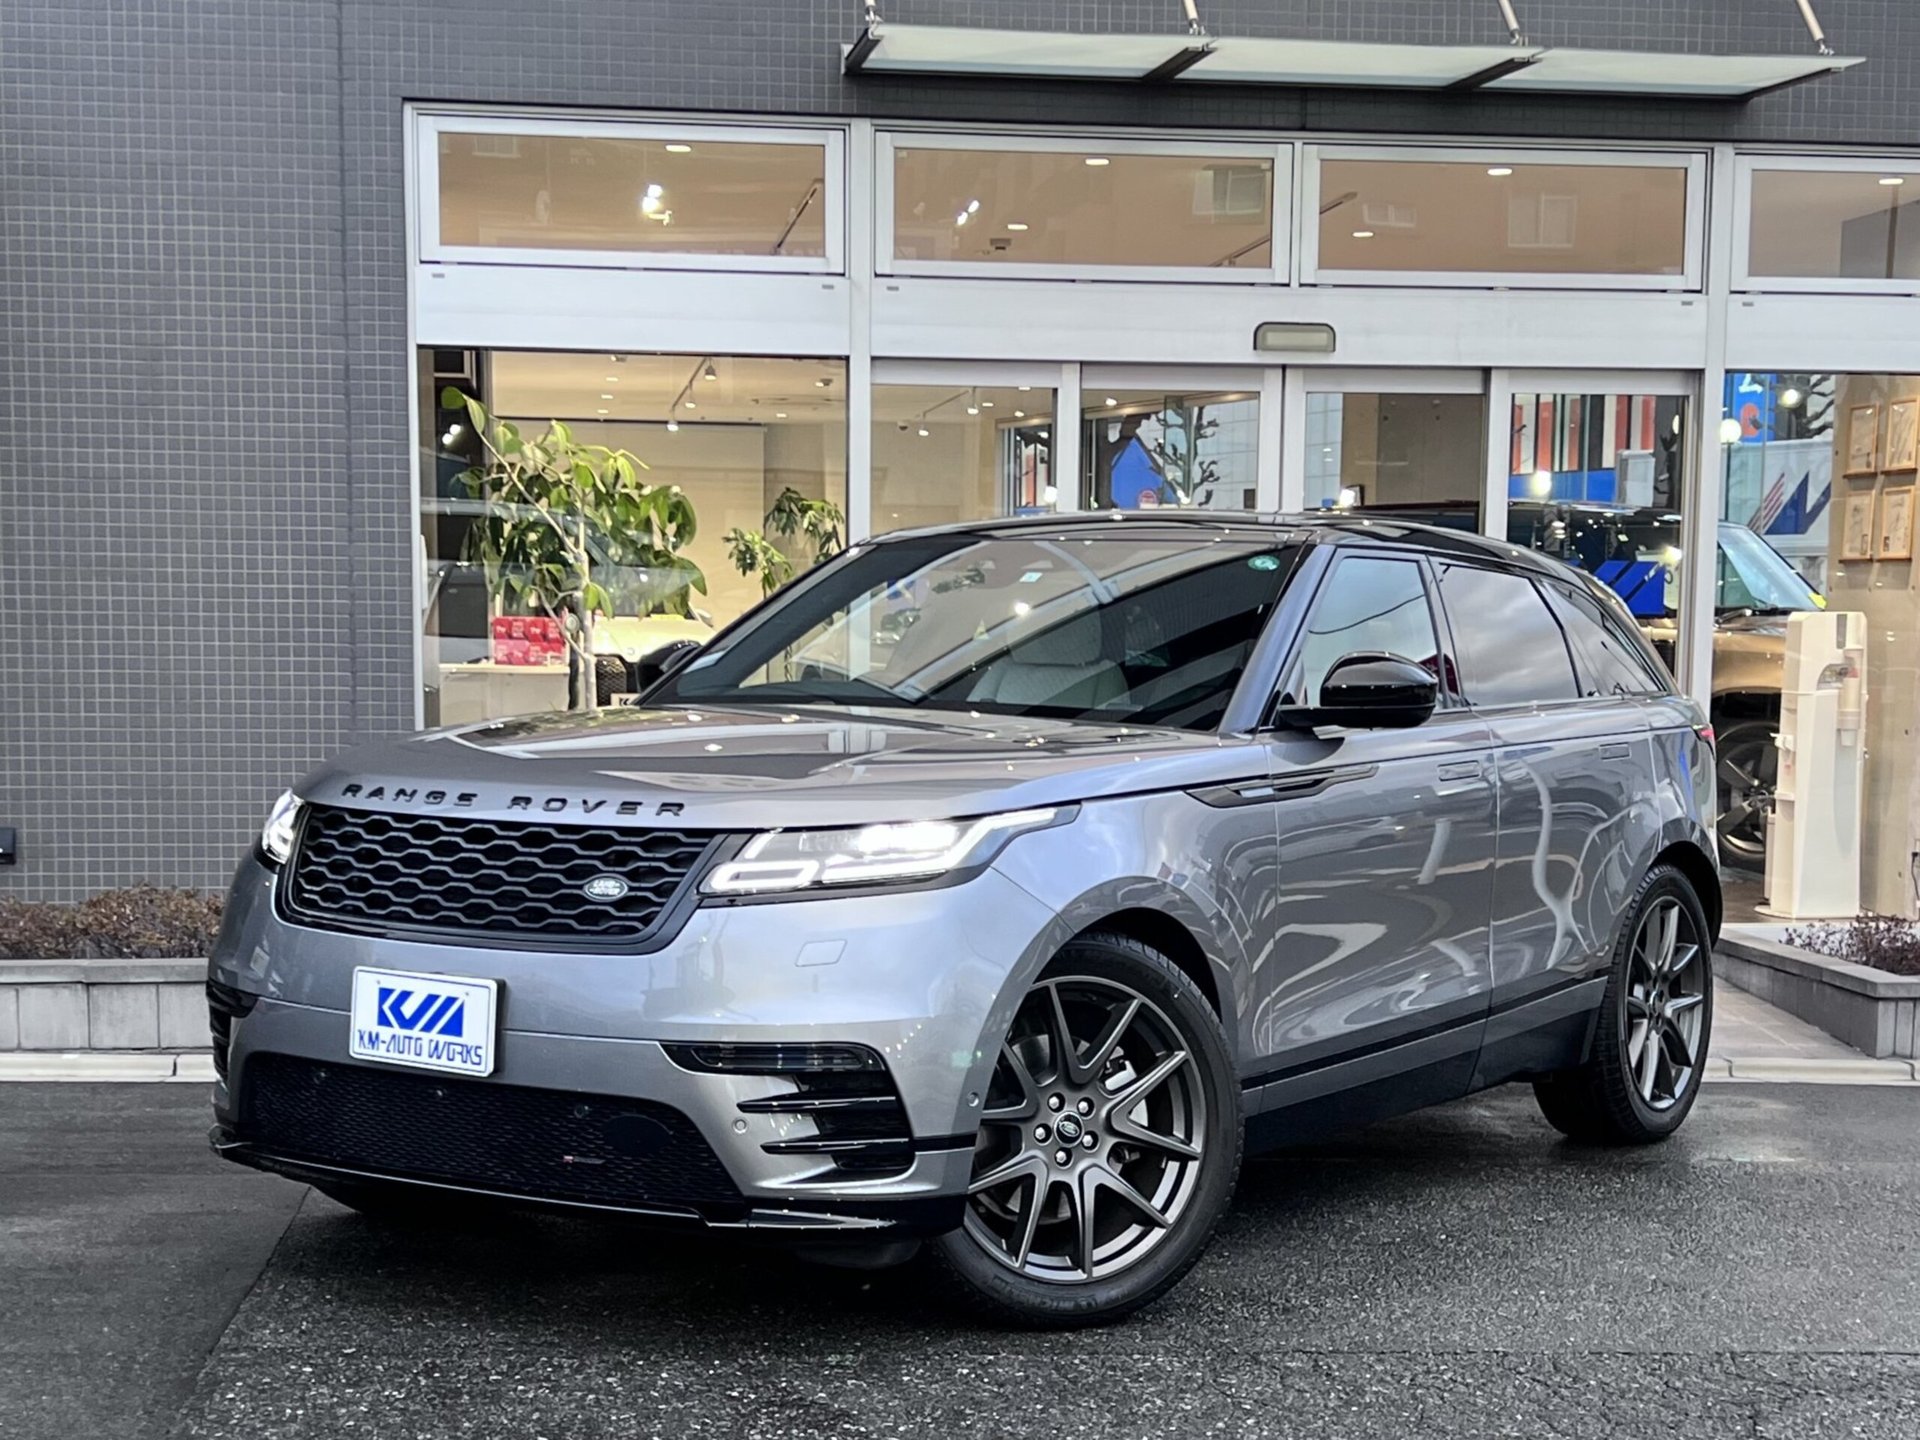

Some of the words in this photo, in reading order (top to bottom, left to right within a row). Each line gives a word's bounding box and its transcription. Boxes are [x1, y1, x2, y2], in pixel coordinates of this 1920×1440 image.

[341, 783, 478, 807] RANGE
[506, 796, 686, 817] ROVER
[357, 1029, 423, 1057] KM-AUTO
[428, 1039, 483, 1066] WORKS
